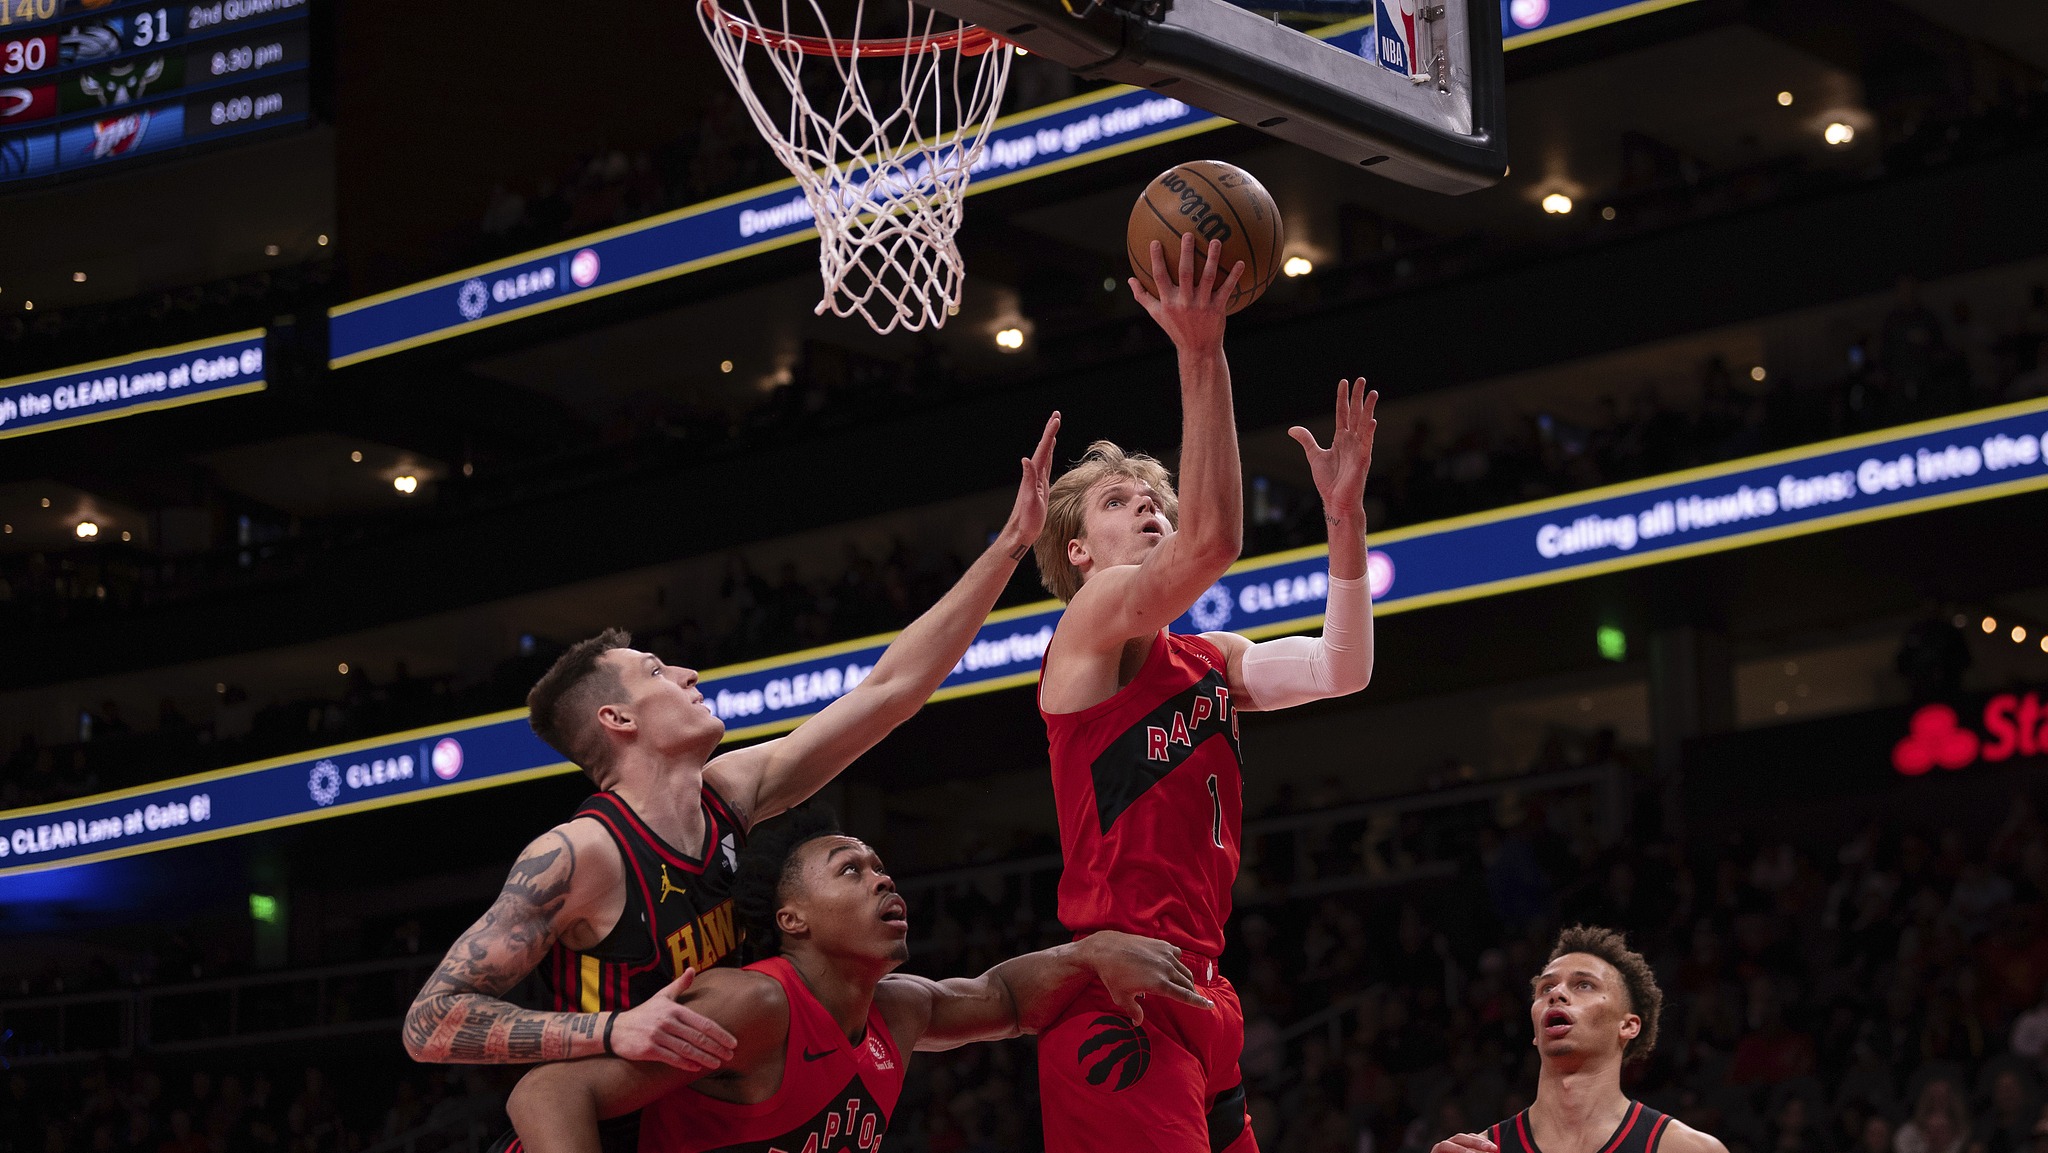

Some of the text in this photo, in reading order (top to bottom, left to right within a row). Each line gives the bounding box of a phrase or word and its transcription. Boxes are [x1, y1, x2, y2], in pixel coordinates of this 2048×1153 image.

[133, 8, 171, 47] 31
[189, 2, 223, 29] 2nd
[4, 37, 46, 74] 30
[254, 43, 283, 70] pm
[1381, 36, 1404, 67] NBA
[254, 93, 283, 120] pm
[991, 138, 1037, 169] App
[1036, 128, 1062, 155] to
[1062, 114, 1102, 153] get
[1160, 171, 1232, 244] Wilson
[492, 266, 556, 303] CLEAR
[19, 393, 51, 417] the
[53, 376, 118, 410] CLEAR
[119, 371, 167, 398] Lane
[168, 363, 190, 389] at
[191, 355, 239, 384] Gate
[240, 347, 263, 375] 6!
[1536, 514, 1639, 559] Calling
[1638, 500, 1676, 539] all
[1675, 485, 1778, 532] Hawks
[1857, 454, 1917, 495] Get
[1916, 445, 1982, 484] into
[1981, 433, 2040, 471] the
[1238, 571, 1329, 613] CLEAR
[716, 688, 764, 720] free
[763, 667, 843, 710] CLEAR
[346, 755, 414, 789] CLEAR
[11, 820, 77, 854] CLEAR
[78, 817, 123, 844] Lane
[123, 808, 144, 835] at
[144, 801, 189, 831] Gate
[189, 793, 212, 822] 6!
[1206, 773, 1225, 848] 1
